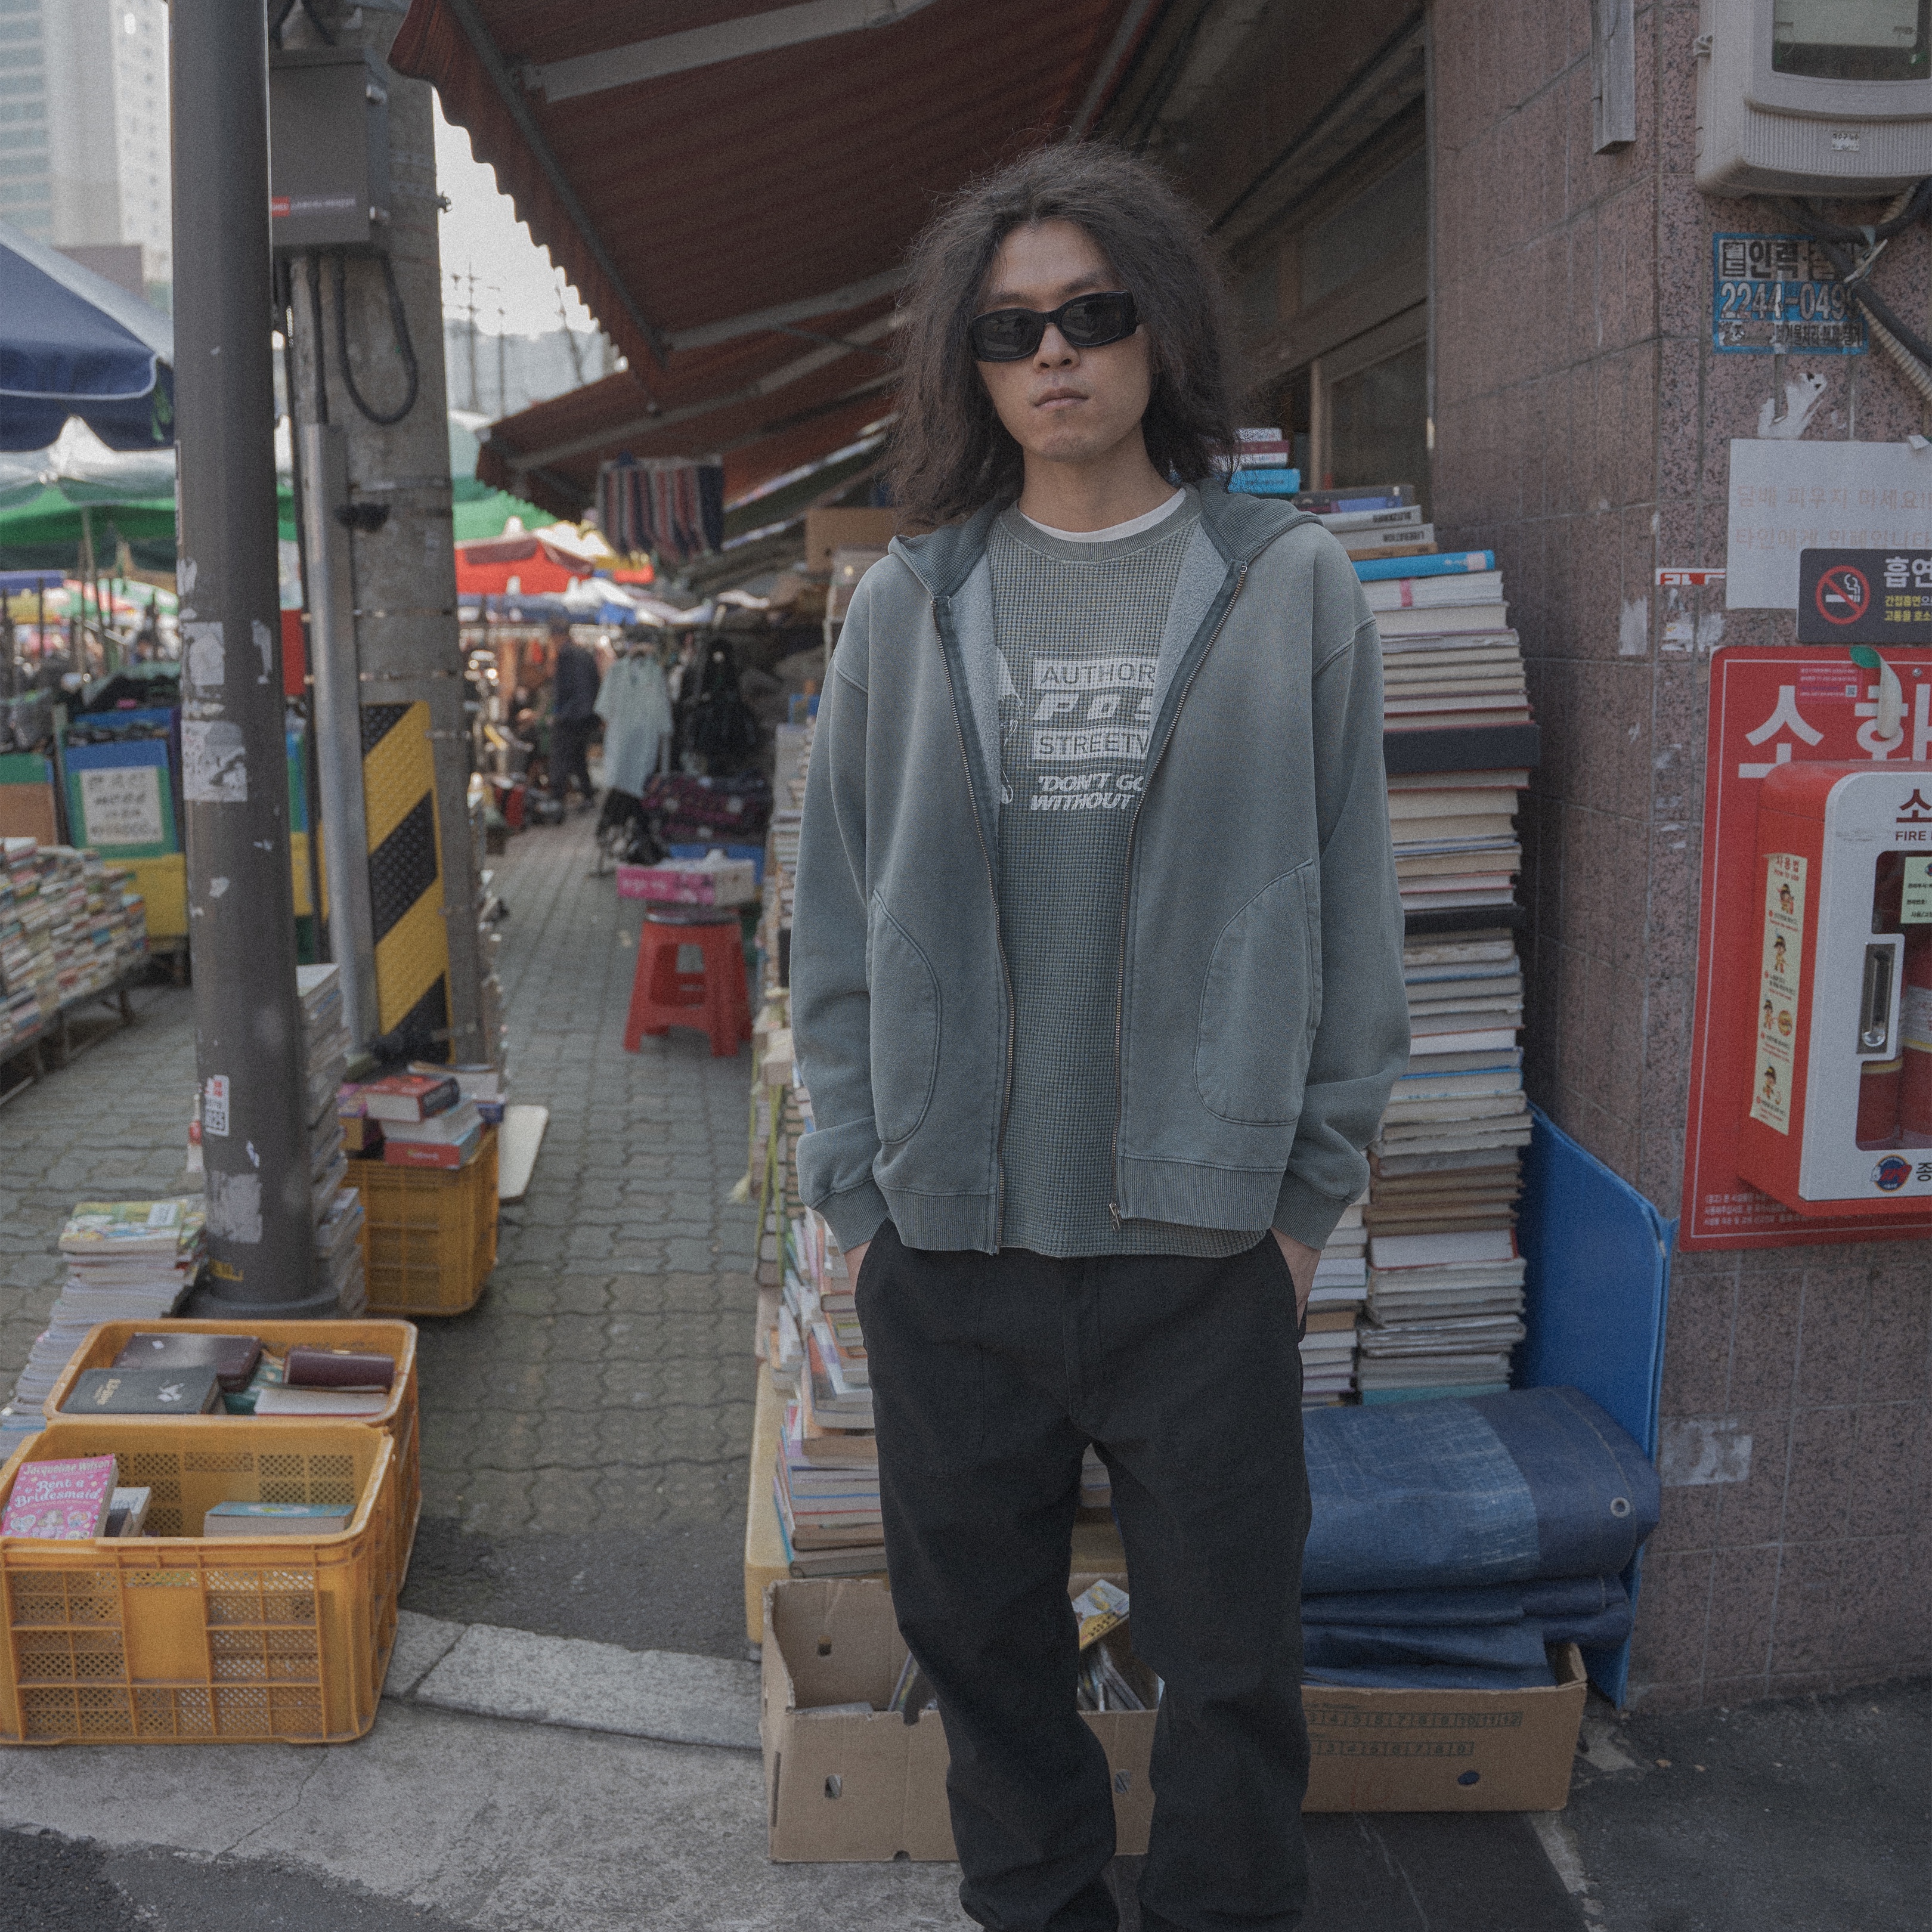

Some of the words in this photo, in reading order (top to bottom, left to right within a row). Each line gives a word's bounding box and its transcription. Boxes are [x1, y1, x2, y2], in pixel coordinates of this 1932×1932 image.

[1883, 556, 1932, 588] 흡연
[1884, 595, 1932, 608] 간접흡연으
[1042, 662, 1156, 685] AUTHOR
[1030, 792, 1135, 810] WITHOUT
[1895, 831, 1927, 841] FIRE
[23, 1464, 76, 1476] Jacqueline
[35, 1478, 72, 1492] Rent
[14, 1487, 103, 1508] Bridesmaid
